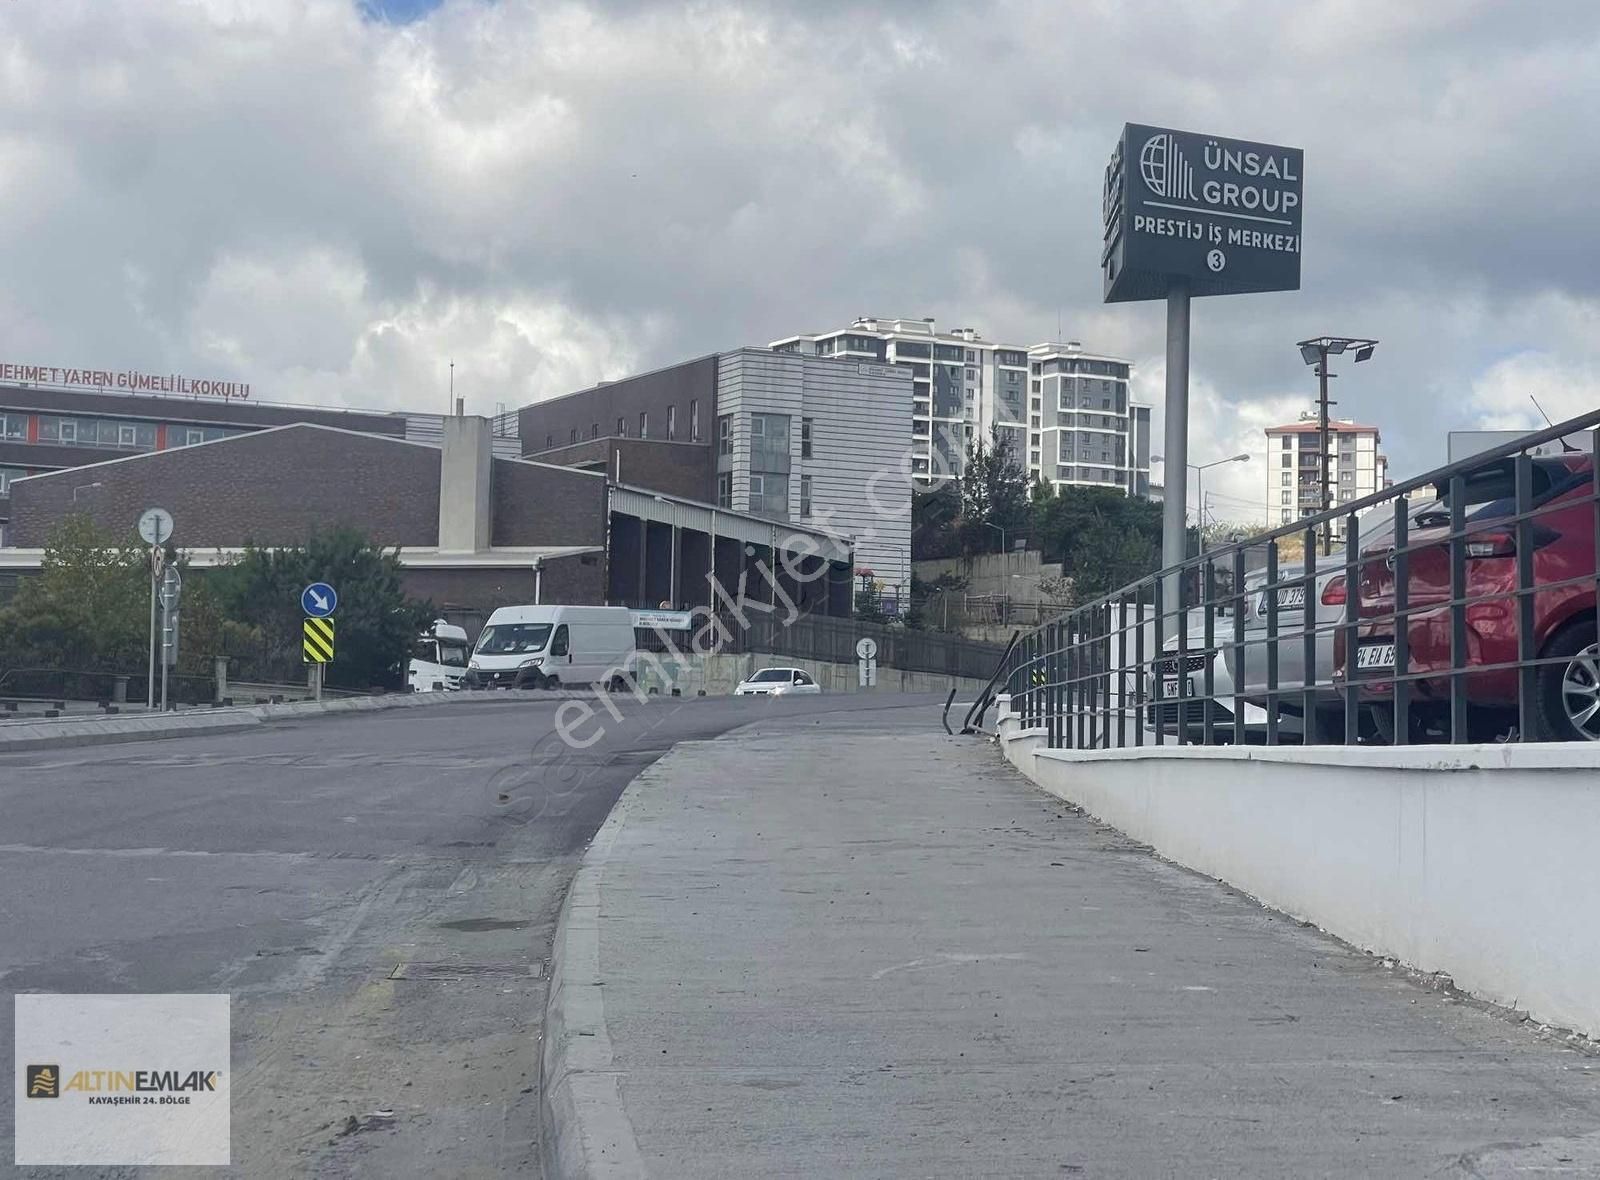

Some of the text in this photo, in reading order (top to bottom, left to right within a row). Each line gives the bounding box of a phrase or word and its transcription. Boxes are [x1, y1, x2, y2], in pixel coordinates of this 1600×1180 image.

[1204, 140, 1298, 181] ÜNSAL
[1202, 181, 1299, 213] GROUP
[1134, 215, 1203, 240] PRESTİJ
[1208, 222, 1222, 245] İŞ
[0, 364, 250, 397] EHMET YAREN GÜMELİ İLKOKULU
[1368, 647, 1383, 665] EIA
